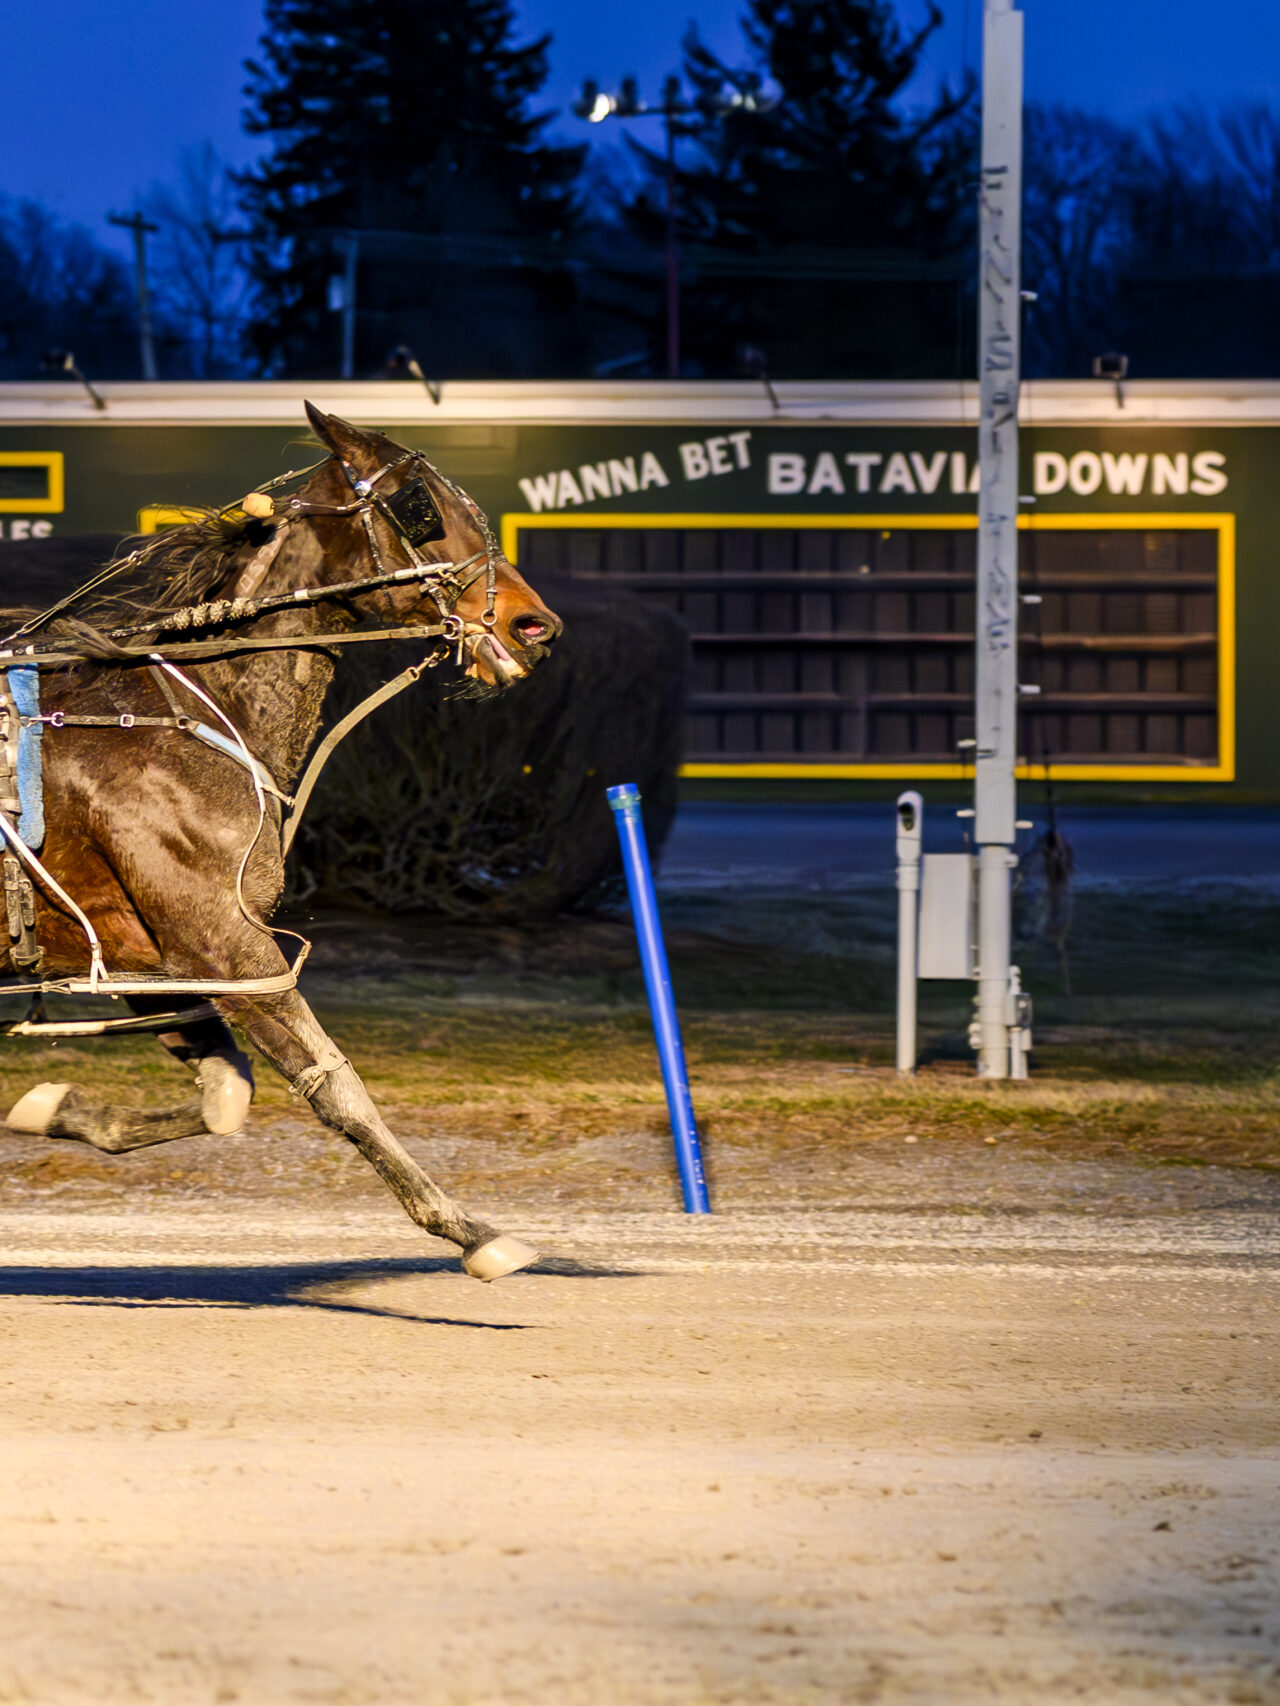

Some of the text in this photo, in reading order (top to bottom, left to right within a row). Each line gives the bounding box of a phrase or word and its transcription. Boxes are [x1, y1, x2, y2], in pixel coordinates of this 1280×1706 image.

[519, 431, 751, 512] WANNA BET
[769, 451, 1229, 496] BATAVI DOWNS
